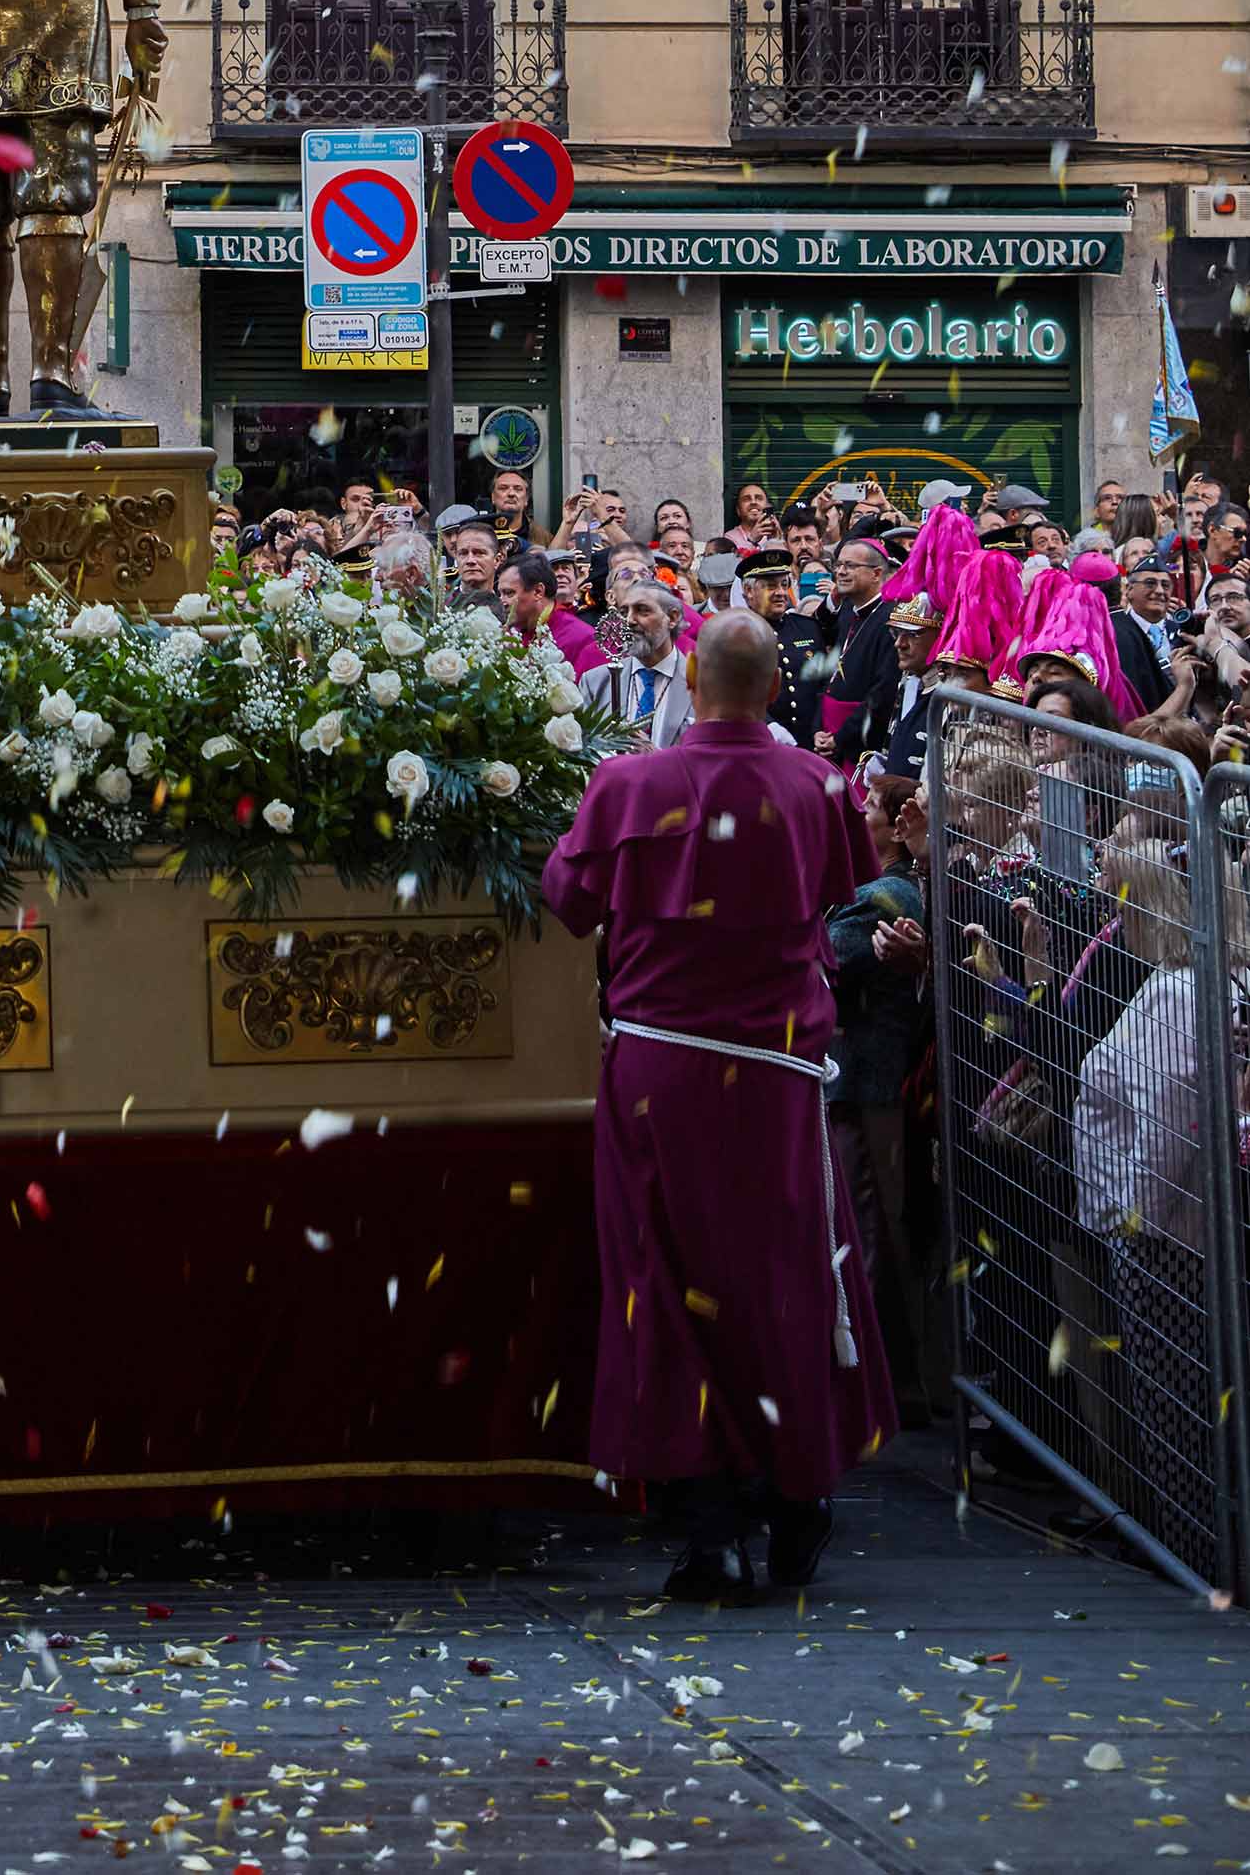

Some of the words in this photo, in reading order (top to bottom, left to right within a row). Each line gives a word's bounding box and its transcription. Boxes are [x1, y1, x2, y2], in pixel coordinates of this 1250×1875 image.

[193, 235, 303, 262] HERBO
[608, 237, 780, 265] DIRECTOS
[796, 238, 841, 265] DE
[857, 238, 1107, 267] LABORATORIO
[486, 250, 544, 261] EXCEPTO
[498, 263, 533, 273] E.M.T.
[734, 303, 1067, 359] Herbolario
[385, 335, 420, 344] 0101034
